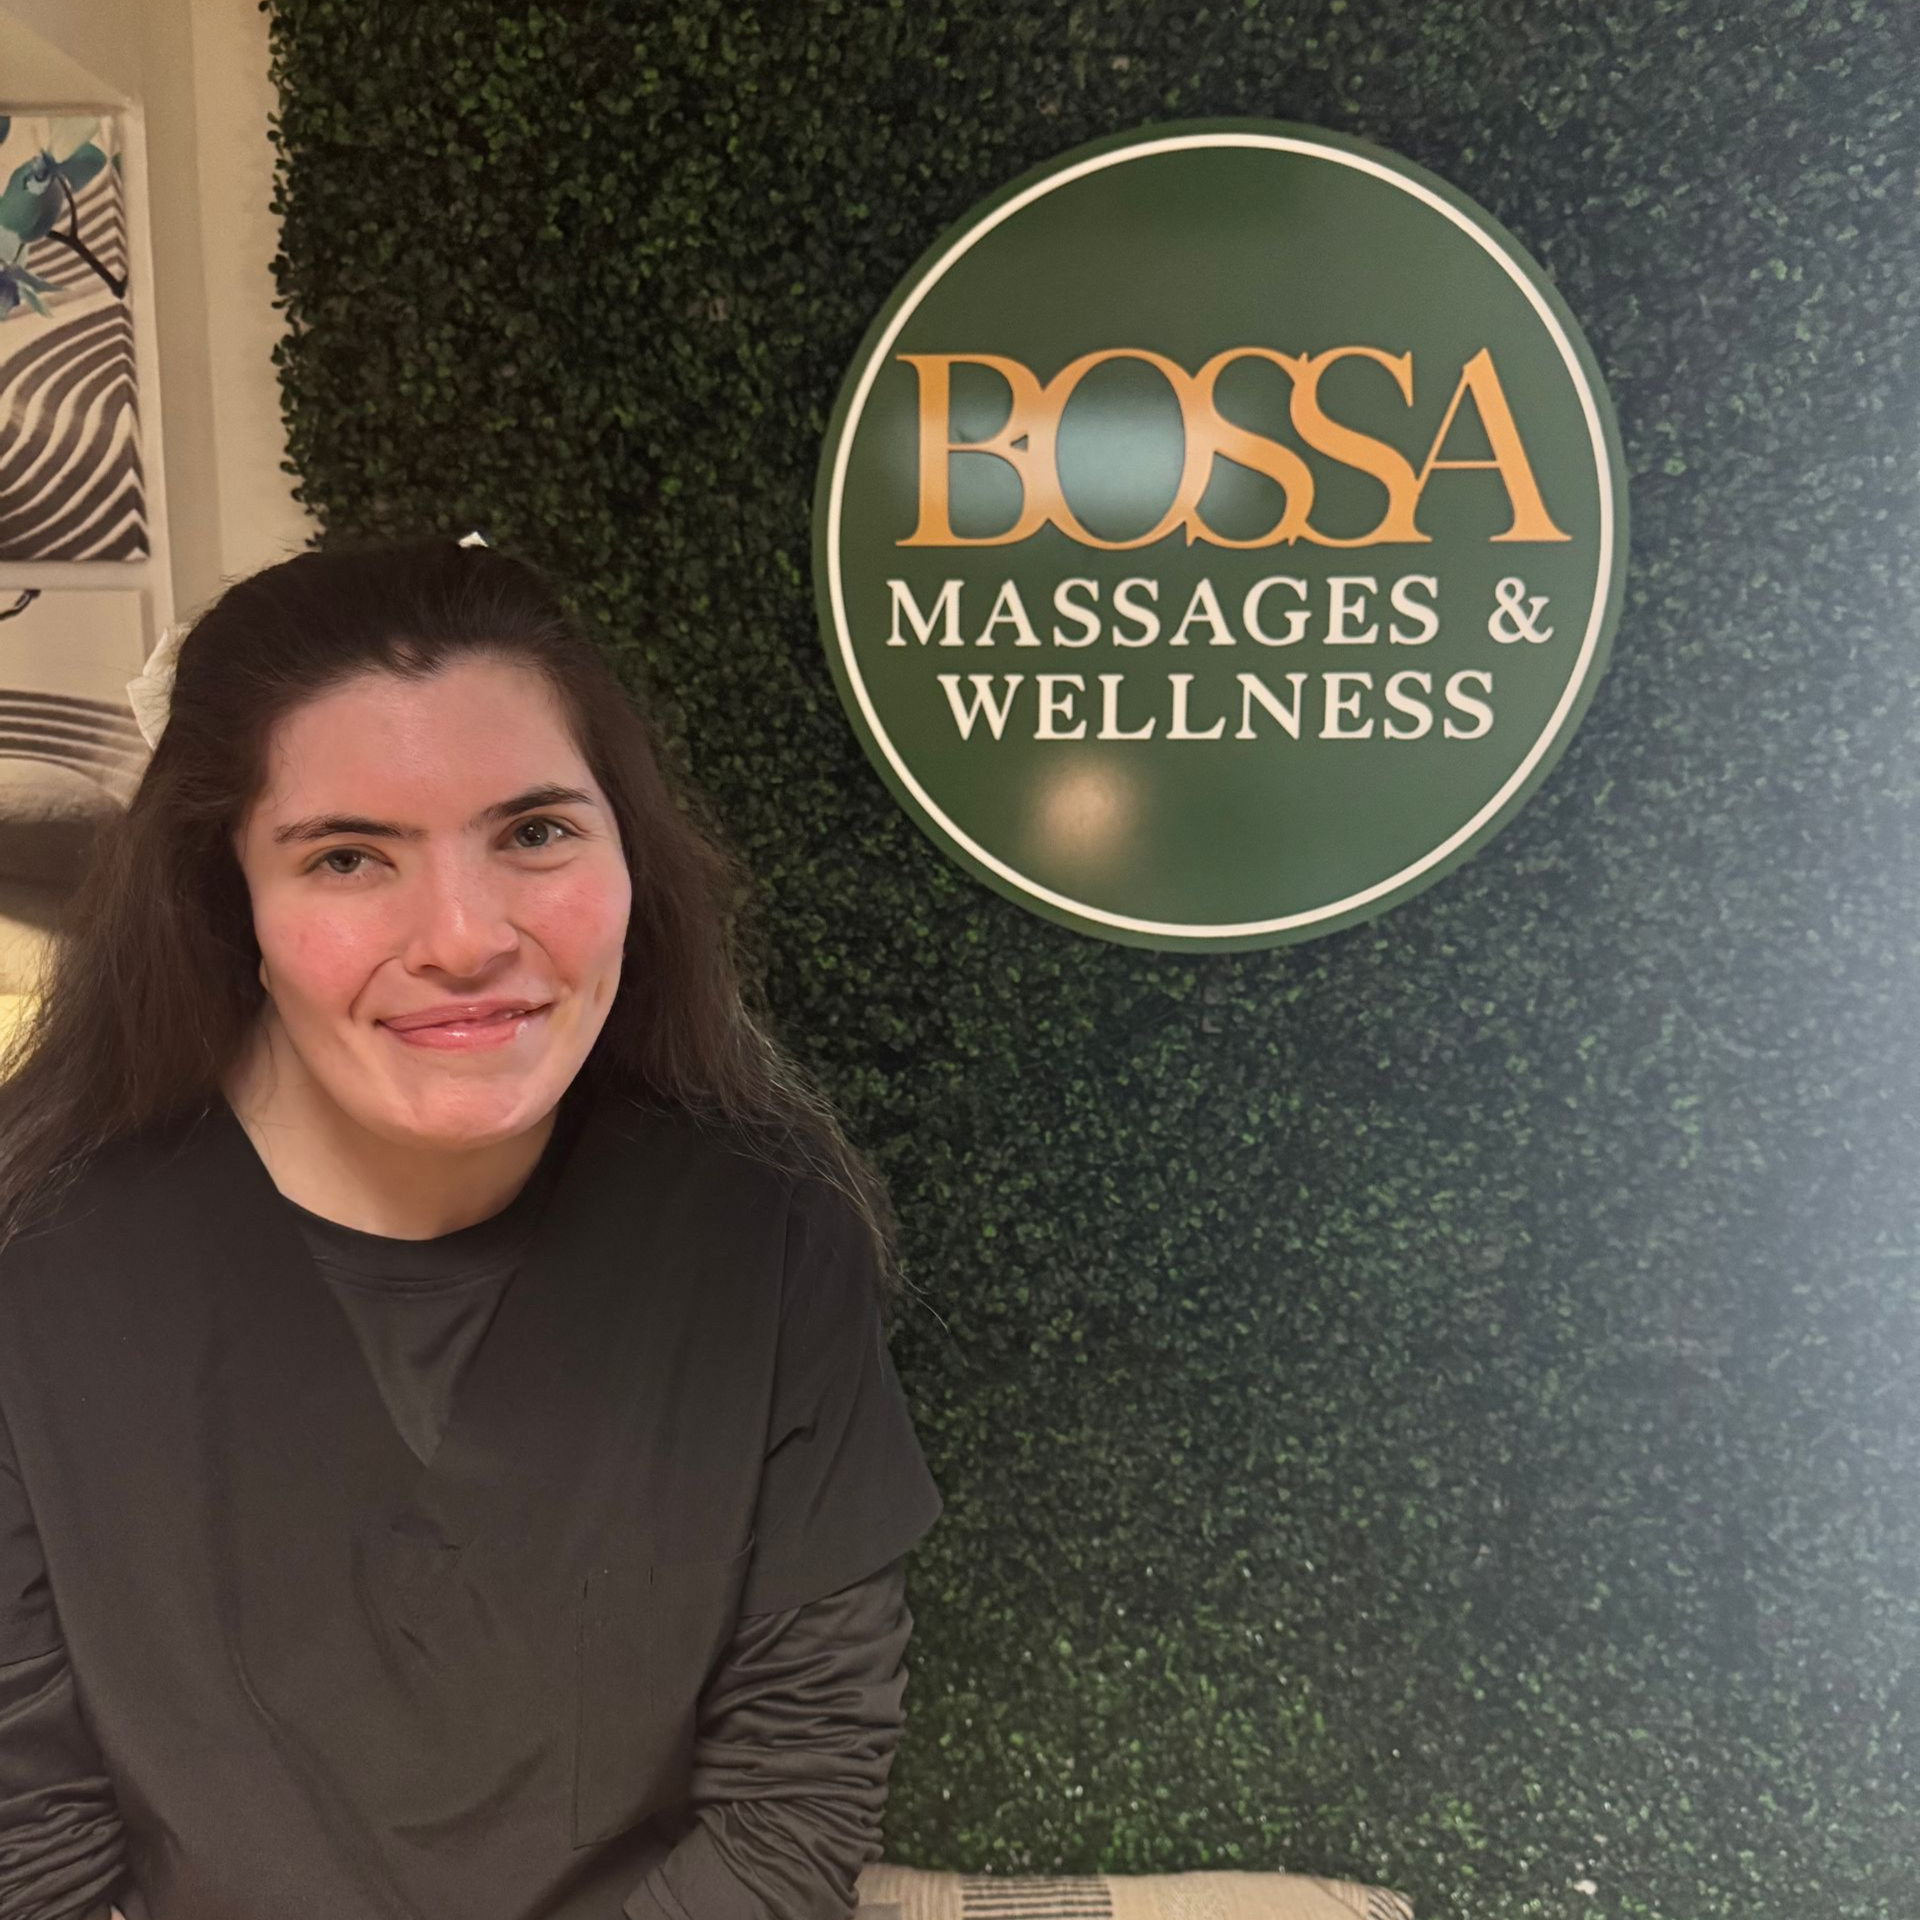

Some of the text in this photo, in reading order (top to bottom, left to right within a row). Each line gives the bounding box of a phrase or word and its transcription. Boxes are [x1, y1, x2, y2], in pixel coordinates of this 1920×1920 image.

[895, 346, 1572, 550] BOSSA
[886, 574, 1555, 648] MASSAGES &
[936, 669, 1495, 741] WELLNESS
